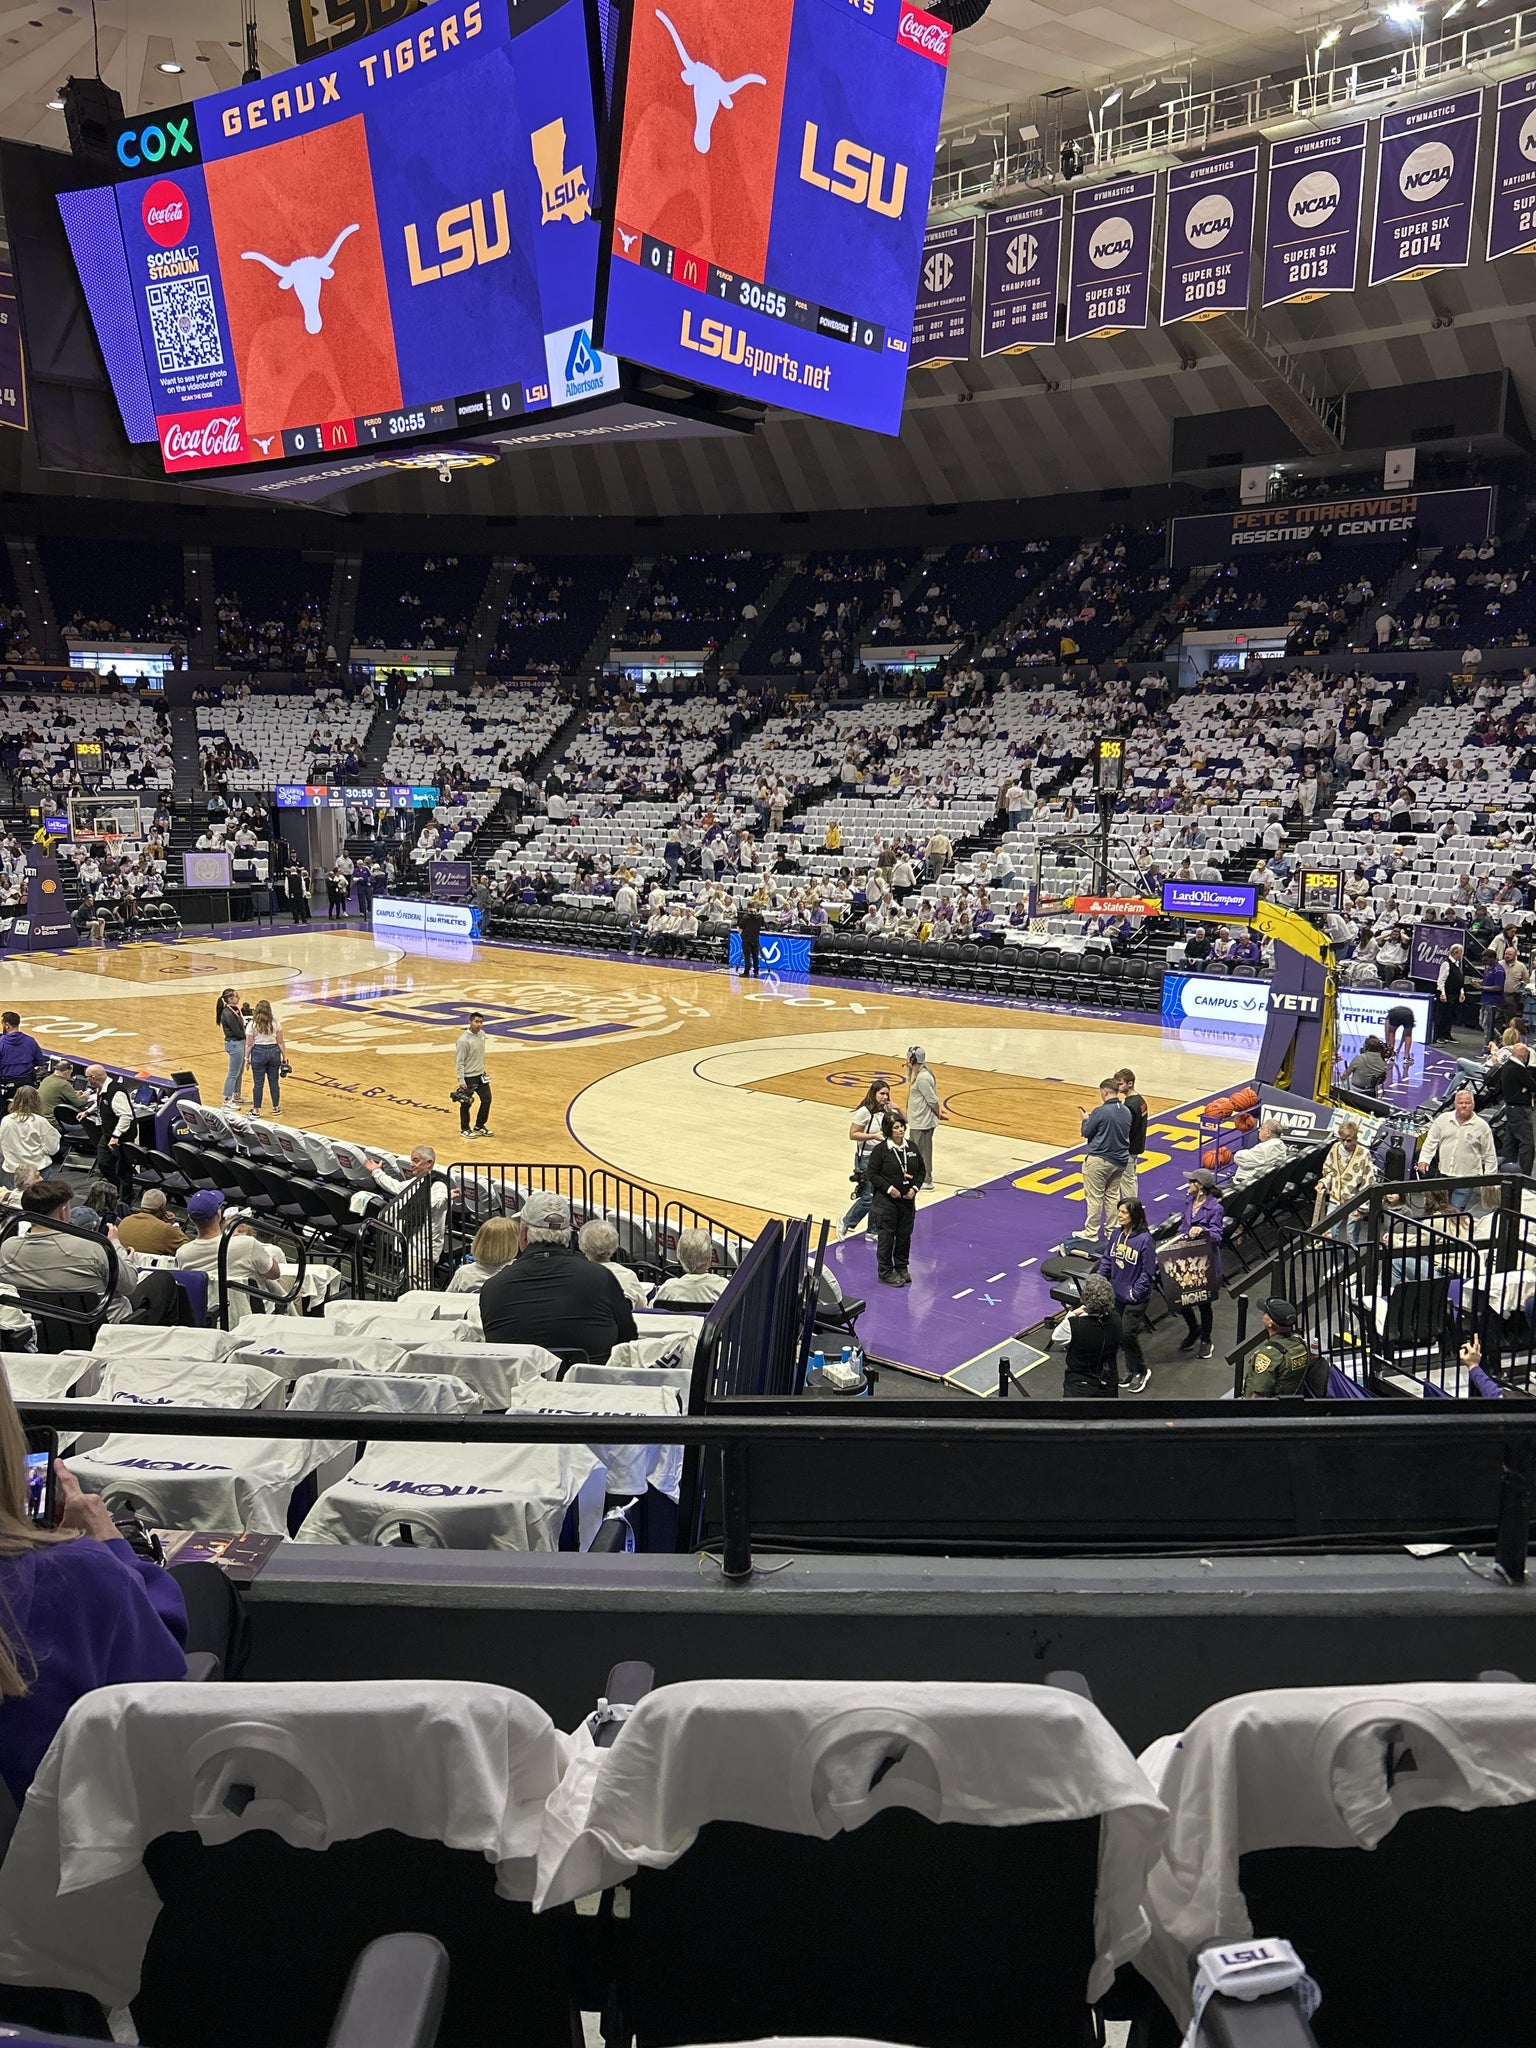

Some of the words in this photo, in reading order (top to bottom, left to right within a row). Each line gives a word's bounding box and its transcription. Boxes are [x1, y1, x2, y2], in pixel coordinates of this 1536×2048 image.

[900, 12, 950, 56] Coca-Cola
[222, 71, 340, 137] GEAUX
[359, 1, 483, 87] TIGERS
[1406, 105, 1455, 126] GYMNASTICS
[117, 118, 193, 167] COX
[1294, 136, 1342, 155] GYMNASTICS
[800, 120, 908, 220] LSU
[1190, 161, 1234, 179] GYMNASTICS
[1404, 165, 1451, 191] NCAA
[1503, 172, 1536, 187] NATIONA
[545, 178, 577, 213] LSU
[1094, 185, 1134, 201] GYMNASTICS
[147, 201, 183, 226] Coca-Cola
[1293, 194, 1337, 216] NCAA
[1190, 217, 1231, 238] NCAA
[1394, 224, 1428, 239] SUPER
[1432, 216, 1450, 230] SIX
[403, 190, 511, 287] LSU
[1093, 239, 1132, 258] NCAA
[1399, 233, 1441, 259] 2014
[147, 248, 188, 268] SOCIAL
[651, 248, 661, 267] 0
[1006, 233, 1039, 275] SEC
[1283, 248, 1315, 264] SUPER
[1319, 243, 1337, 256] SIX
[149, 259, 199, 280] STADIUM
[716, 269, 733, 282] PERIOD
[923, 252, 954, 292] SEC
[1181, 267, 1212, 284] SUPER
[1216, 264, 1232, 277] SIX
[1289, 259, 1328, 283] 2013
[720, 282, 726, 297] 1
[1001, 277, 1041, 292] CHAMPIONS
[1085, 287, 1113, 302] SUPER
[1116, 284, 1131, 295] SIX
[1185, 279, 1226, 302] 2009
[739, 282, 787, 318] 30:55
[1088, 298, 1126, 320] 2008
[819, 316, 850, 334] POWERADE
[863, 330, 874, 346] 0
[887, 337, 907, 353] LSU
[680, 310, 832, 392] LSUsports.net
[160, 376, 177, 387] Want
[177, 375, 184, 384] to
[184, 374, 195, 383] see
[195, 374, 209, 384] your
[209, 370, 227, 380] photo
[175, 384, 186, 393] the
[186, 378, 223, 391] videoboard?
[565, 375, 605, 397] Albertsons
[501, 392, 511, 411] 0
[525, 384, 549, 404] LSU
[430, 404, 445, 414] POSS.
[363, 417, 382, 427] PERIOD
[389, 412, 426, 434] 30:55
[164, 415, 244, 461] Coca-Cola
[294, 433, 305, 450] 0
[371, 426, 377, 439] 1
[1232, 510, 1290, 529] PETE
[1295, 496, 1418, 523] MARAVICH
[1231, 524, 1333, 546] ASSEMBY
[1338, 516, 1417, 536] CENTER
[77, 744, 101, 754] 30:55
[313, 796, 321, 806] 0
[345, 789, 374, 798] 30:55
[399, 797, 407, 807] 0
[1305, 873, 1338, 888] 30:55
[376, 909, 395, 918] CAMPUS
[402, 912, 422, 921] FEDERAL
[437, 918, 467, 926] ATHLETICS
[743, 993, 890, 1014] COX
[1194, 995, 1239, 1009] CAMPUS
[1270, 993, 1320, 1013] YETI
[1200, 1121, 1219, 1131] LSU
[1110, 1243, 1139, 1265] LSU
[1218, 1947, 1270, 1966] LSU
